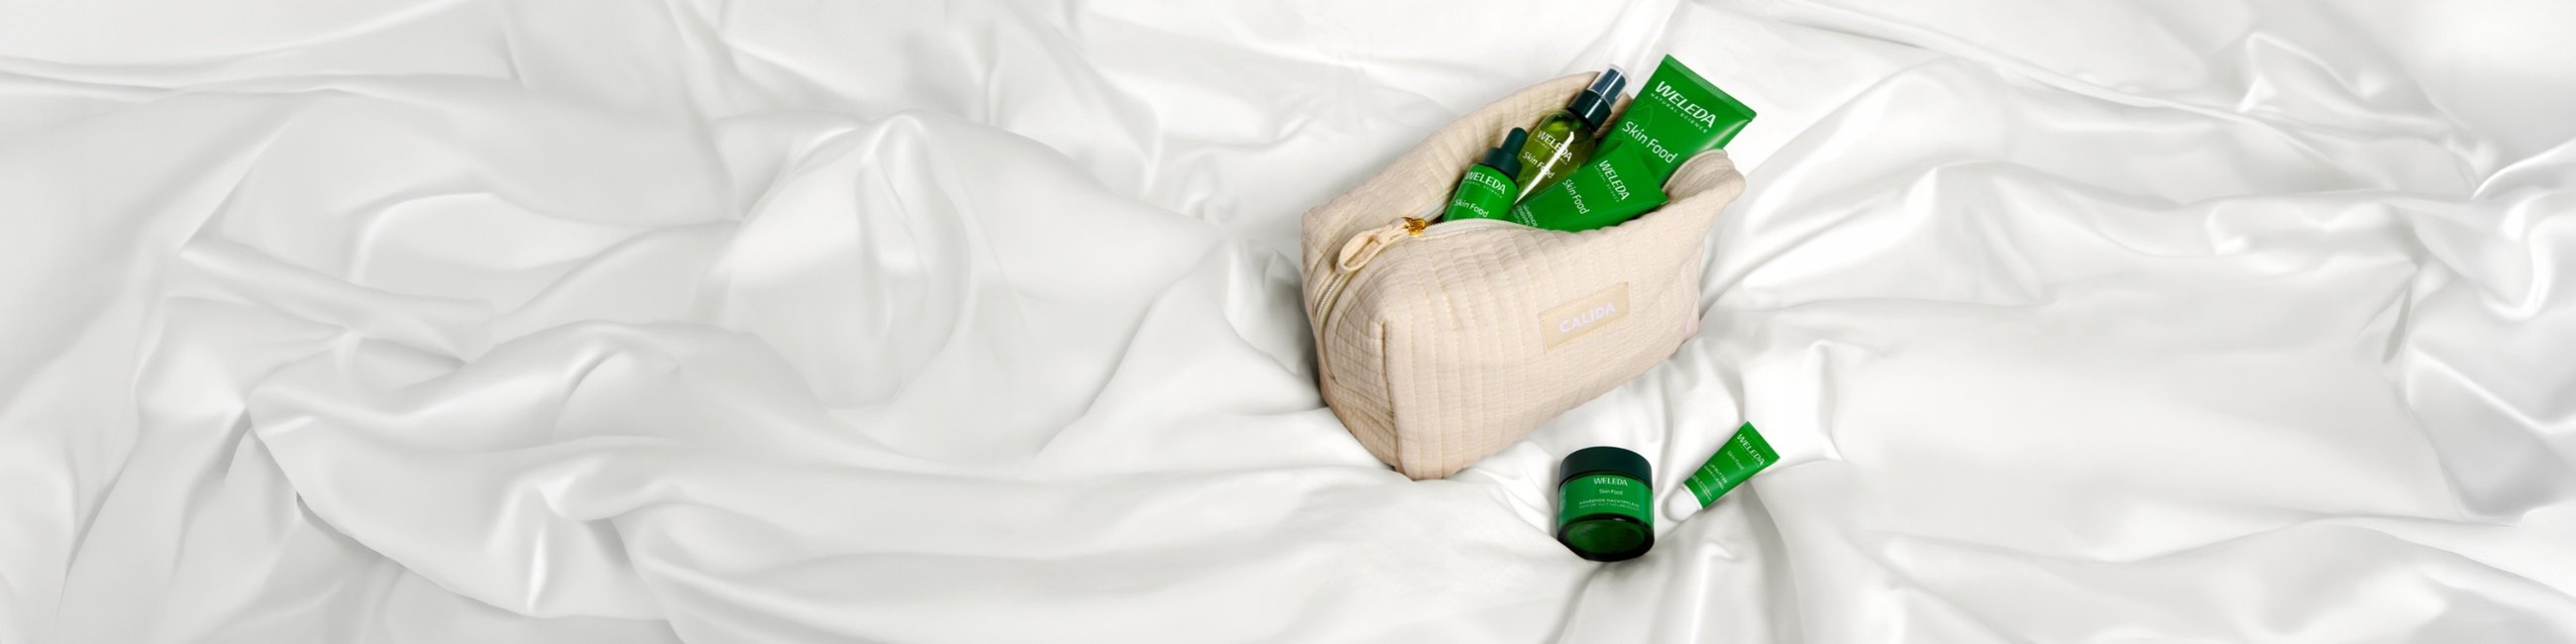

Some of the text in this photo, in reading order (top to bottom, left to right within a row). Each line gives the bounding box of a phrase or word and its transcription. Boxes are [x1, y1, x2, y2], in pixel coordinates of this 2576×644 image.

[1655, 80, 1717, 128] WELEDA
[1523, 151, 1538, 165] Skin
[1622, 121, 1678, 163] Skin Food
[1466, 171, 1506, 195] WELEDA
[1562, 178, 1589, 214] Skin Food
[1598, 160, 1630, 200] WELEDA
[1453, 198, 1489, 217] Skin Food
[1559, 301, 1616, 333] CALIDA
[1737, 433, 1765, 466] WELEDA
[1593, 478, 1628, 486] WELEDA
